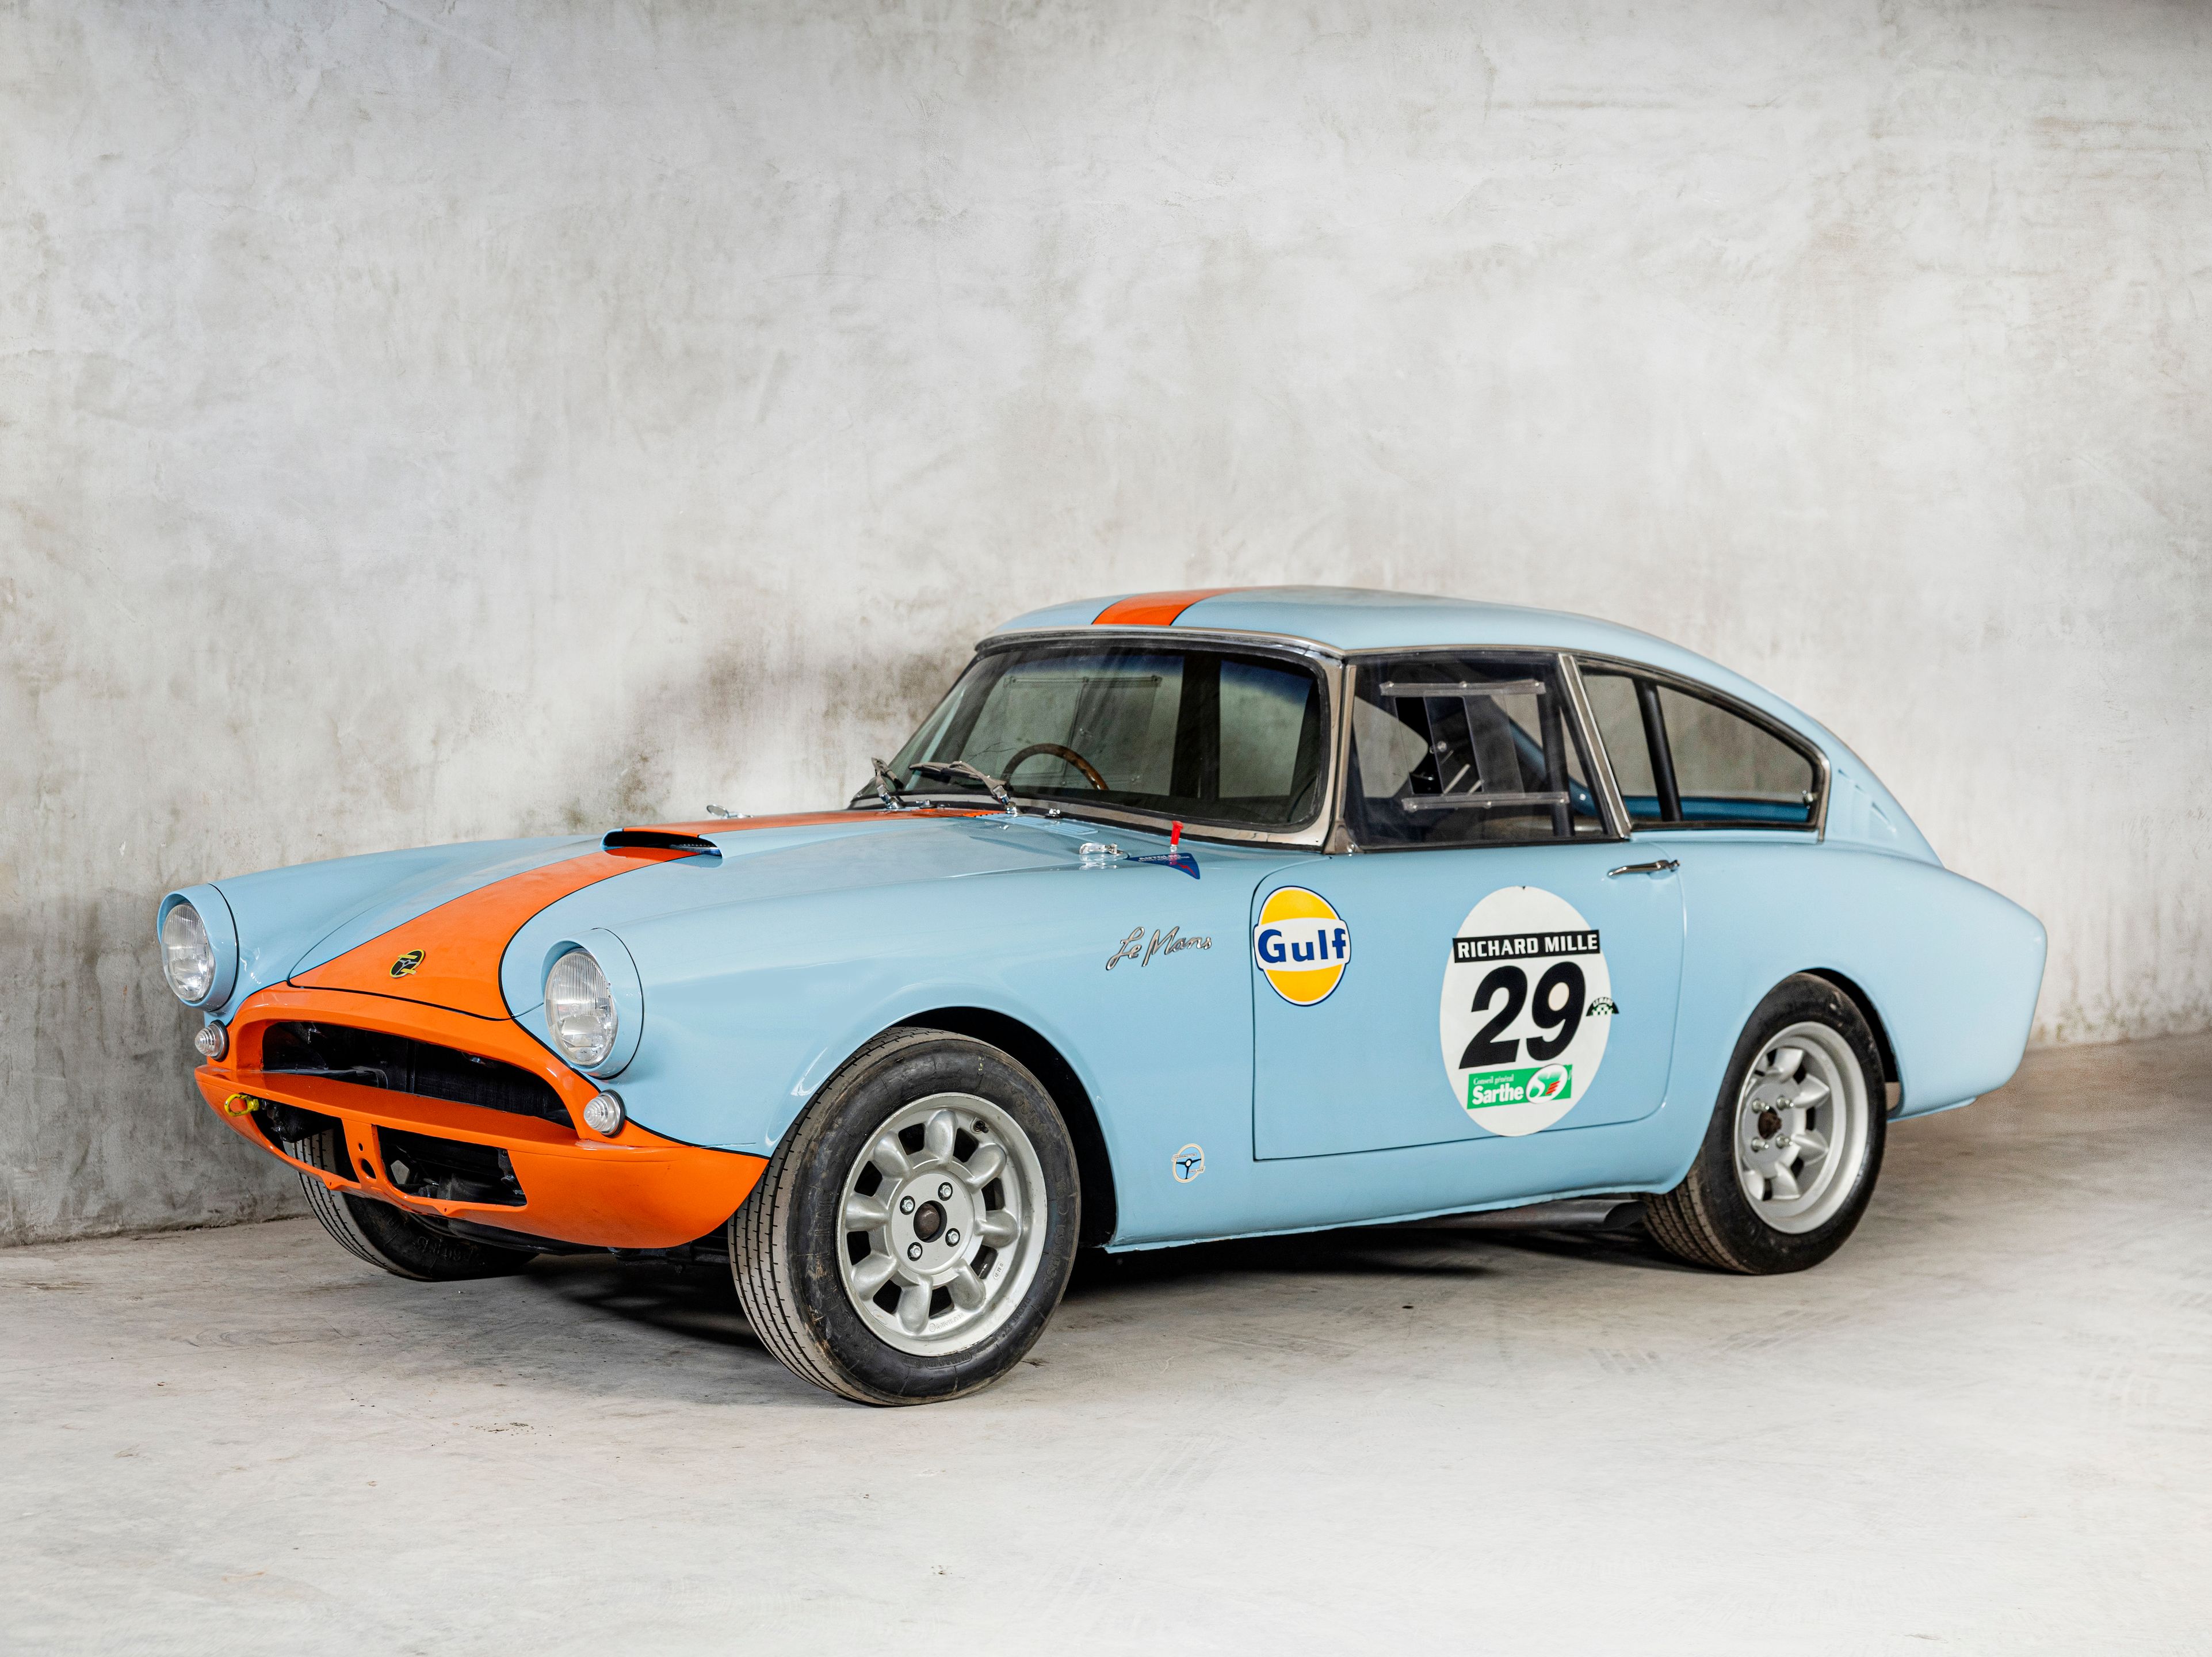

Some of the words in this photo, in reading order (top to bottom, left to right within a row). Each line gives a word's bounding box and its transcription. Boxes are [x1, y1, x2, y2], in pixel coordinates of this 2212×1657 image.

[1106, 926, 1145, 971] Le
[1141, 926, 1212, 967] Mans
[1258, 928, 1346, 964] Gulf
[1458, 937, 1539, 959] RICHARD
[1545, 934, 1598, 953] MILLE
[1458, 961, 1586, 1070] 29
[1472, 1083, 1524, 1105] Sarthe
